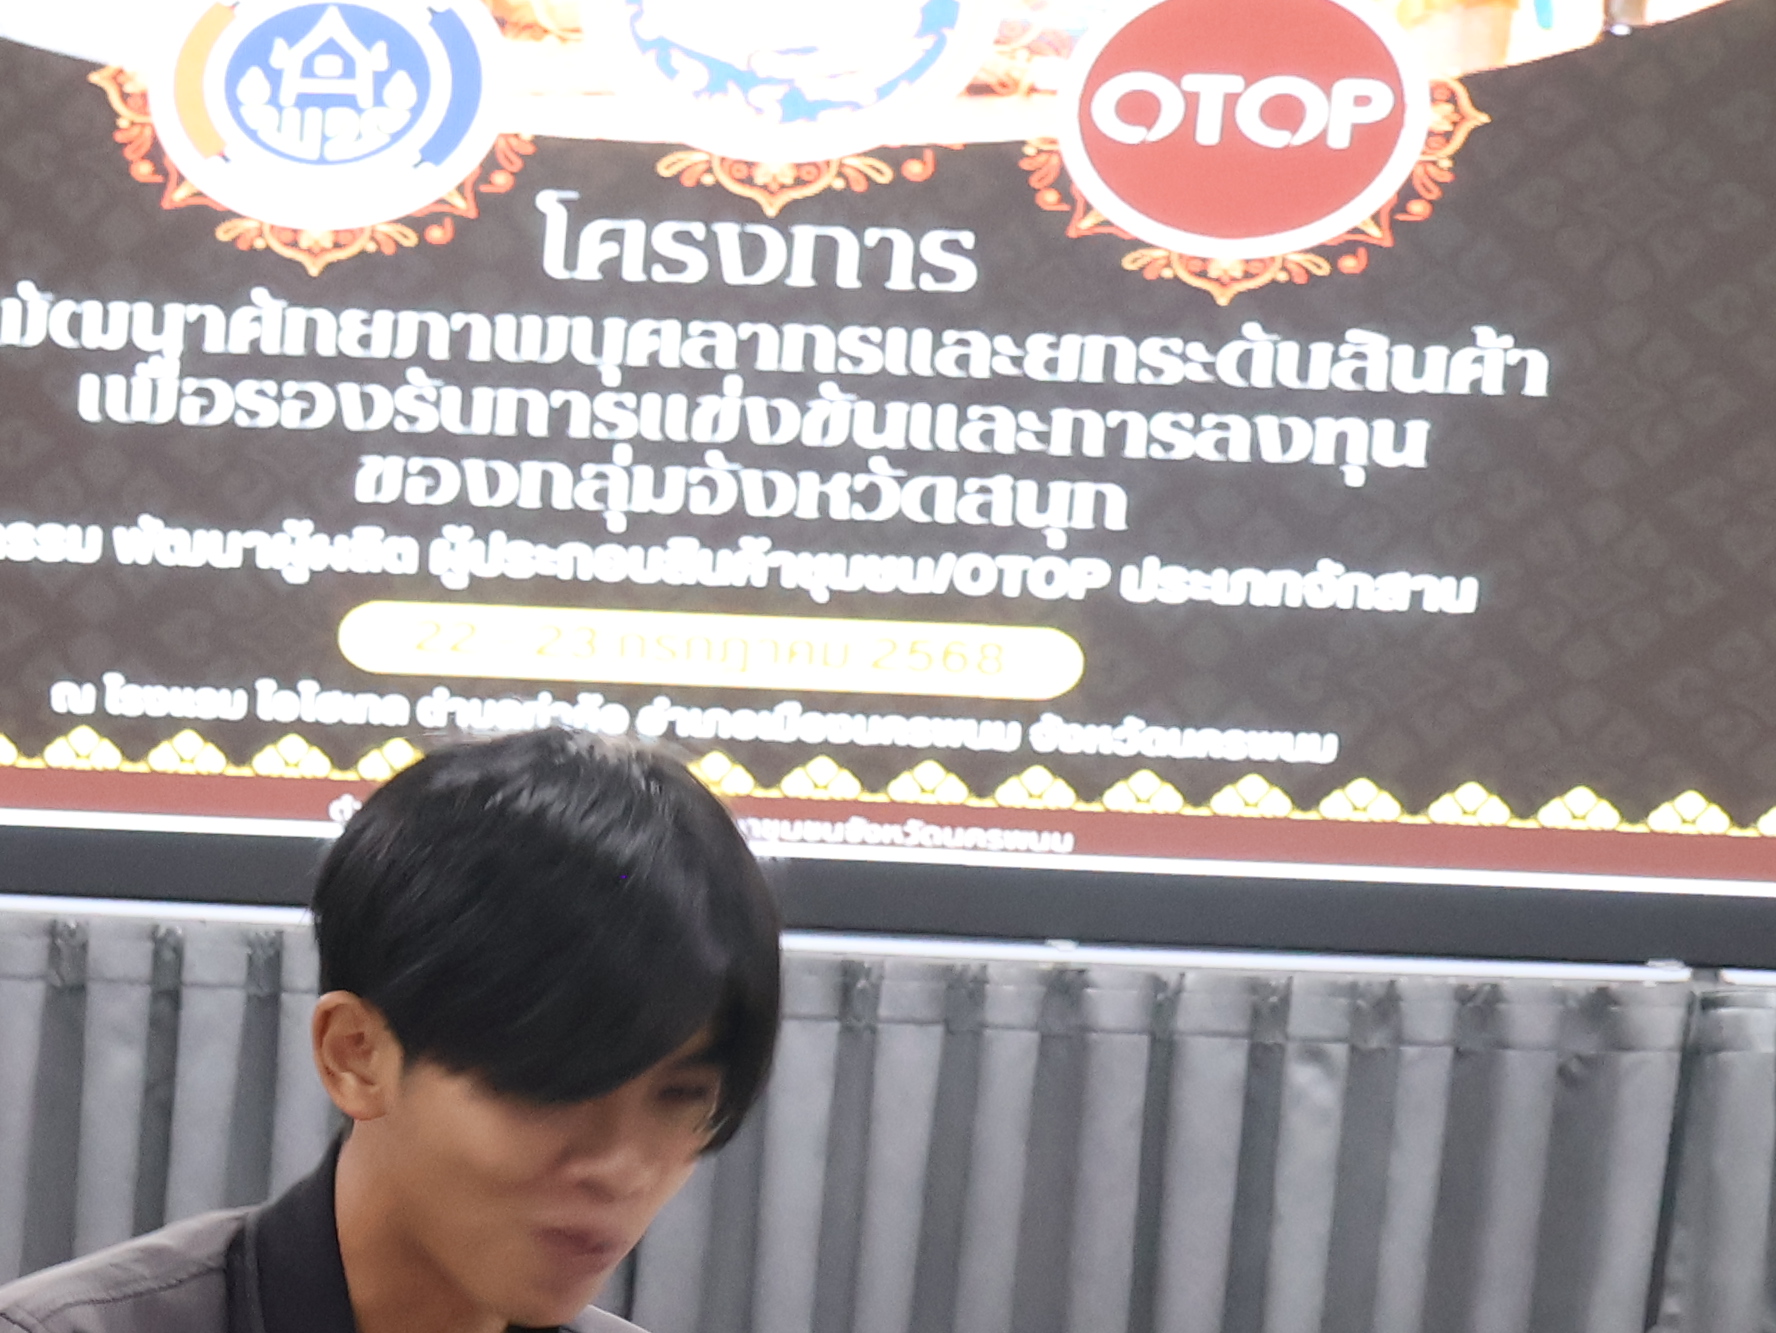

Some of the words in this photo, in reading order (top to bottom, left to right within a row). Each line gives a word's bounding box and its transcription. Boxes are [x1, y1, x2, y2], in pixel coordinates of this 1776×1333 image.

[1090, 71, 1395, 150] OTOP
[535, 189, 978, 292] โครงการ
[77, 357, 1431, 488] เพื่อรองรับการแข่งขันและการลงทุน
[354, 443, 1128, 551] ของกลุ่มจังหวัดสนุก
[112, 514, 420, 585] พัฒนาผู้ผลิต
[1119, 556, 1479, 614] ประเภทจักสาน
[412, 619, 477, 654] 22
[534, 624, 598, 659] 23
[617, 631, 850, 673] กรกฎาคม
[870, 637, 1006, 676] 2568
